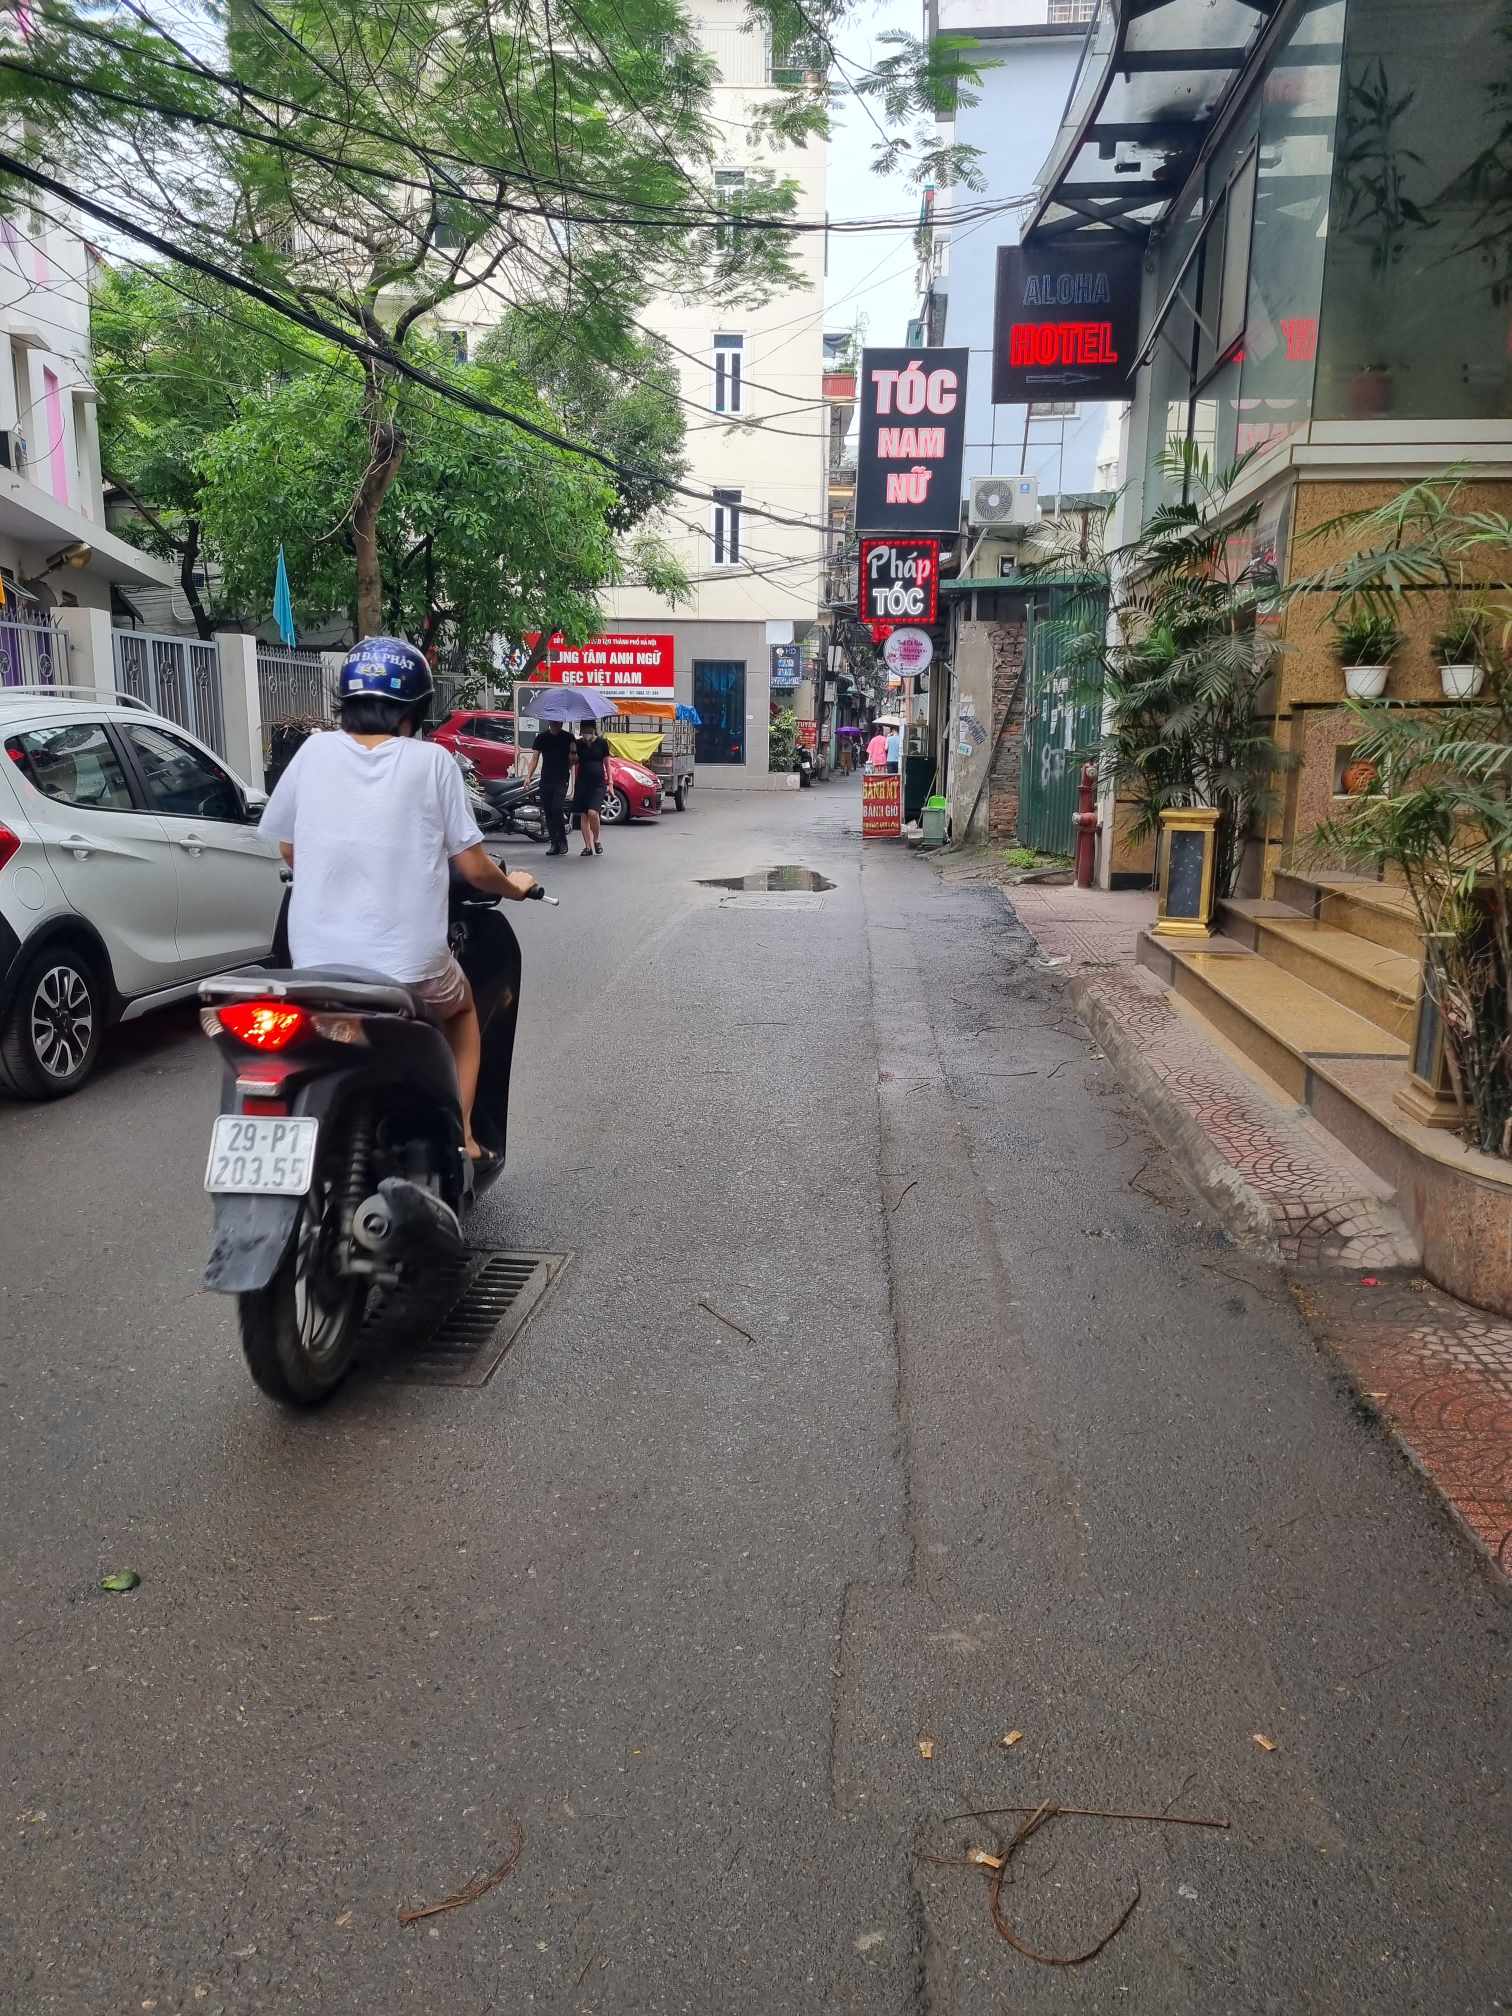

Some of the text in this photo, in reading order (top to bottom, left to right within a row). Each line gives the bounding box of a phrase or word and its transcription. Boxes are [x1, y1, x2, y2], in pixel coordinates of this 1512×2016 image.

[1023, 273, 1111, 305] ALOHA
[1010, 322, 1119, 367] HOTEL
[871, 360, 958, 415] TÓC
[877, 427, 945, 458] NAM
[886, 465, 933, 504] NỮ
[866, 545, 931, 586] Pháp
[872, 581, 925, 616] TÓC
[582, 648, 607, 664] TÂM
[609, 651, 634, 665] ANH
[636, 650, 662, 665] NGỮ
[561, 671, 584, 683] GEC
[614, 671, 642, 684] NAM
[227, 1122, 301, 1154] 29-P1
[214, 1155, 305, 1188] 203.55
